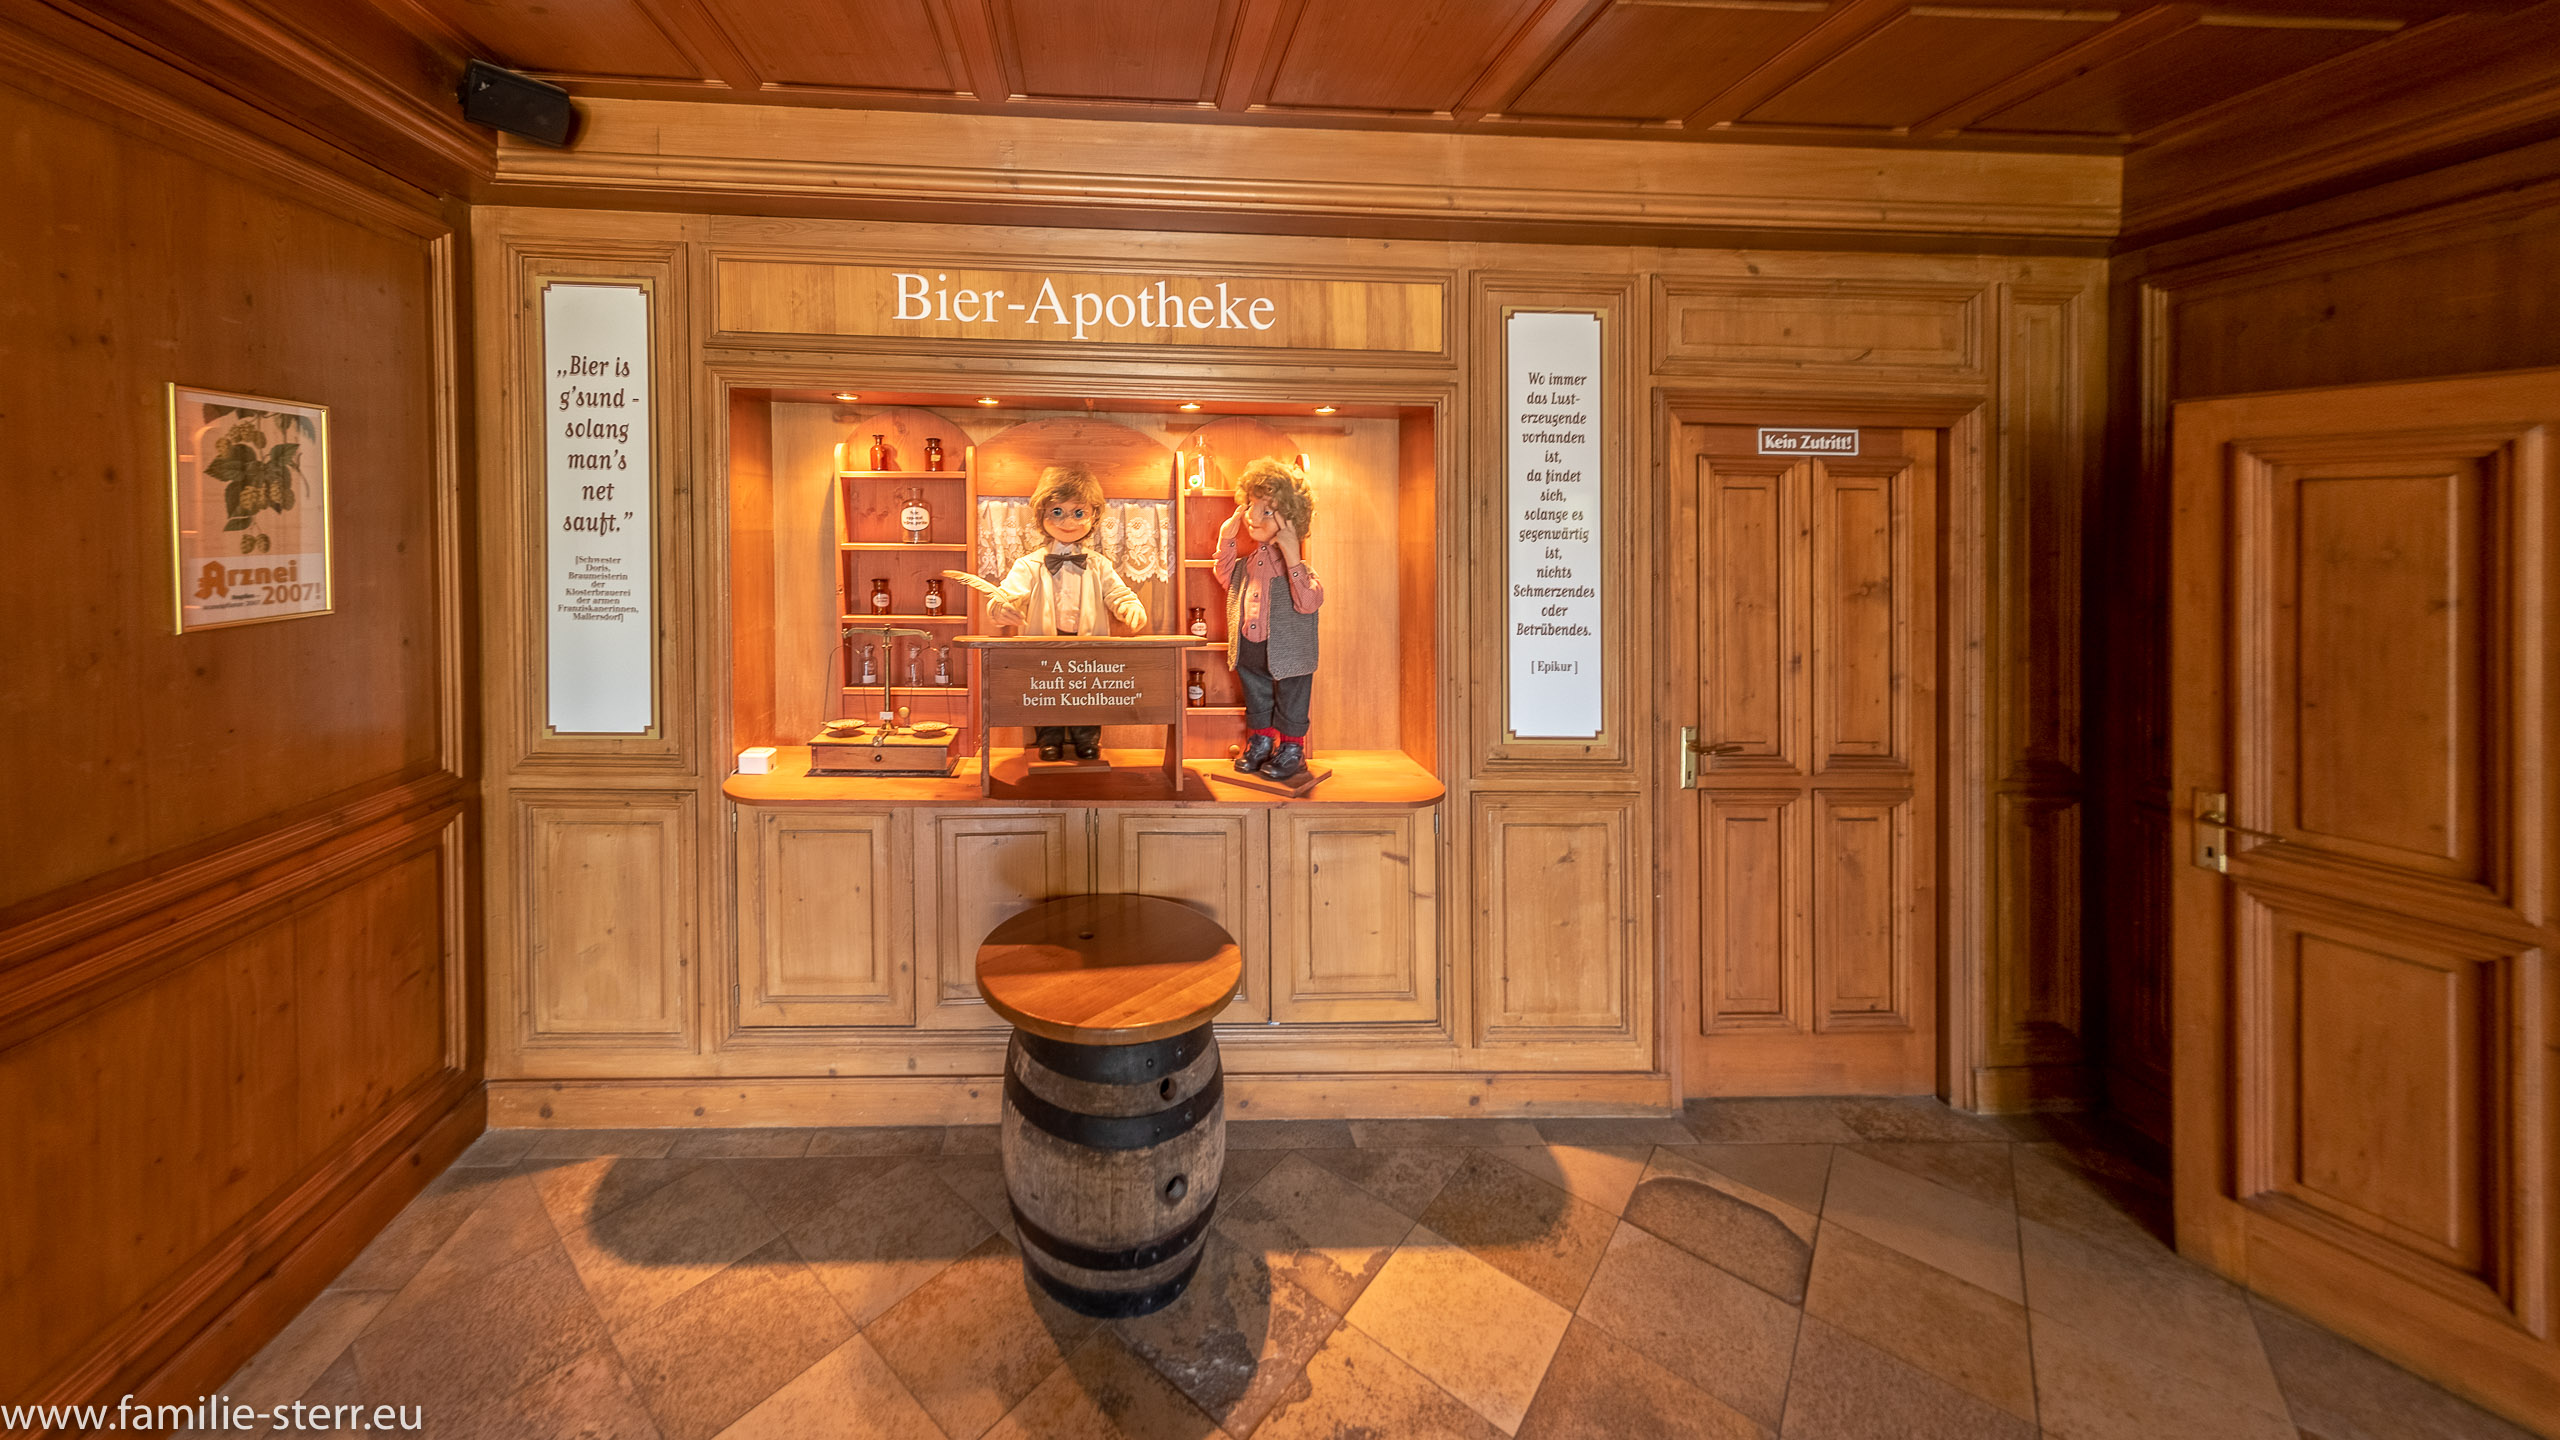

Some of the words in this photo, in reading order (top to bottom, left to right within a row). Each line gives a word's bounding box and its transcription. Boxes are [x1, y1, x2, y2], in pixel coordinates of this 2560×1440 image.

[892, 273, 1276, 340] Bier-Apotheke
[614, 356, 631, 378] is
[1528, 371, 1546, 386] Wo
[1548, 372, 1587, 387] immer
[1527, 391, 1548, 405] das
[1551, 392, 1581, 406] Lust-
[1520, 411, 1587, 428] erzeugende
[565, 418, 630, 445] solang
[1522, 430, 1586, 445] vorhanden
[1764, 433, 1798, 449] Kein
[1800, 434, 1852, 450] Zutritt!
[1544, 449, 1563, 465] ist,
[1526, 469, 1542, 483] da
[1545, 468, 1582, 486] findet
[581, 482, 615, 502] net
[1539, 488, 1567, 503] sich,
[1524, 507, 1568, 524] solange
[1571, 510, 1584, 522] es
[1518, 527, 1590, 544] gegenwärtig
[1544, 545, 1563, 561] ist,
[585, 564, 611, 572] Doris,
[1536, 565, 1572, 579] nichts
[194, 560, 298, 600] Arznei
[568, 571, 628, 581] Braumeisterin
[591, 580, 606, 588] der
[1513, 583, 1596, 598] Schmerzendes
[261, 582, 321, 605] 2007!
[565, 587, 631, 597] Klosterbrauerei
[576, 596, 591, 605] der
[592, 597, 620, 605] armen
[557, 604, 639, 614] Franziskanerinnen,
[1541, 603, 1568, 617] oder
[1516, 622, 1592, 637] Betrübendes.
[1051, 661, 1065, 673] A
[1067, 660, 1126, 673] Schlauer
[1030, 677, 1065, 690] kauft
[1068, 677, 1087, 690] sei
[1091, 676, 1136, 690] Arznei
[1022, 693, 1056, 707] beim
[1060, 692, 1143, 707] Kuchlbauer"
